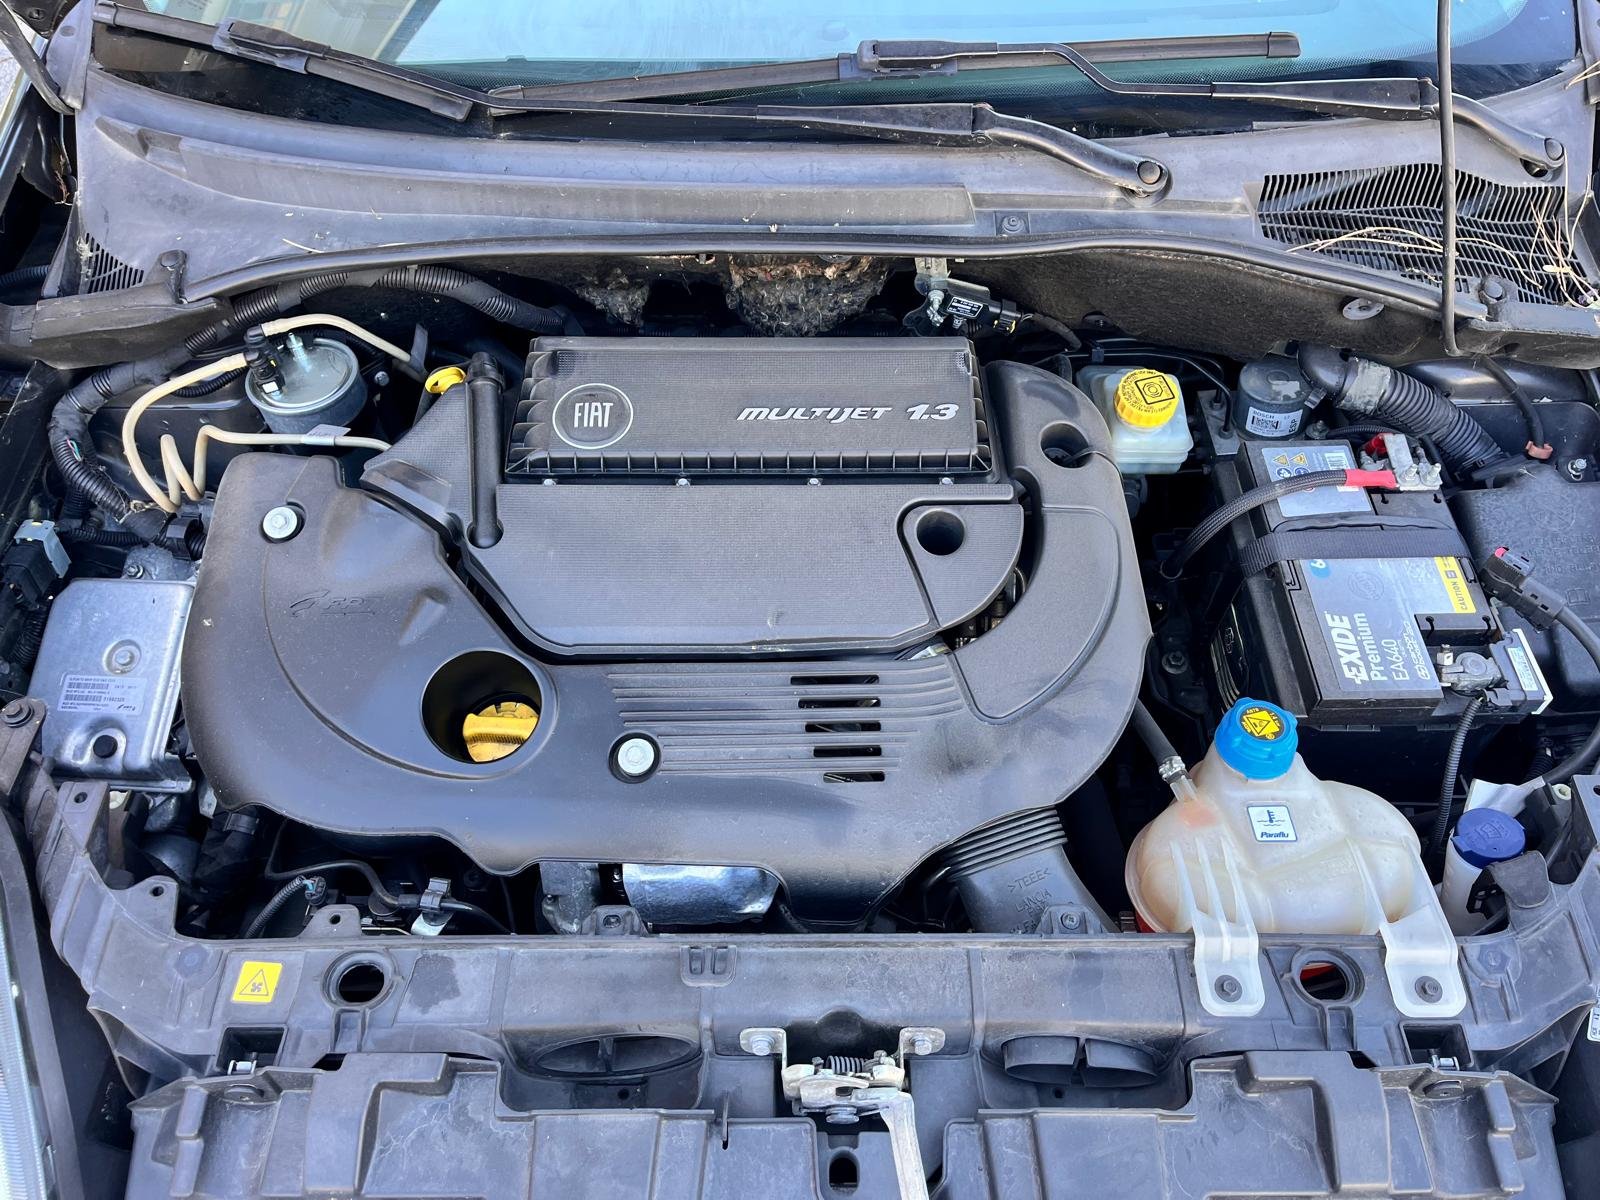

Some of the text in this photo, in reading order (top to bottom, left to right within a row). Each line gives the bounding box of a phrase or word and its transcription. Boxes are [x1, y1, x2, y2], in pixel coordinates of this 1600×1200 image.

[573, 402, 614, 428] FIAT
[736, 403, 960, 424] MULTIJET 1.3
[1288, 418, 1297, 433] ESP
[1451, 580, 1468, 611] CAUTION
[1324, 610, 1370, 685] EXIDE
[1353, 612, 1388, 681] Premium
[1381, 639, 1410, 681] EA640
